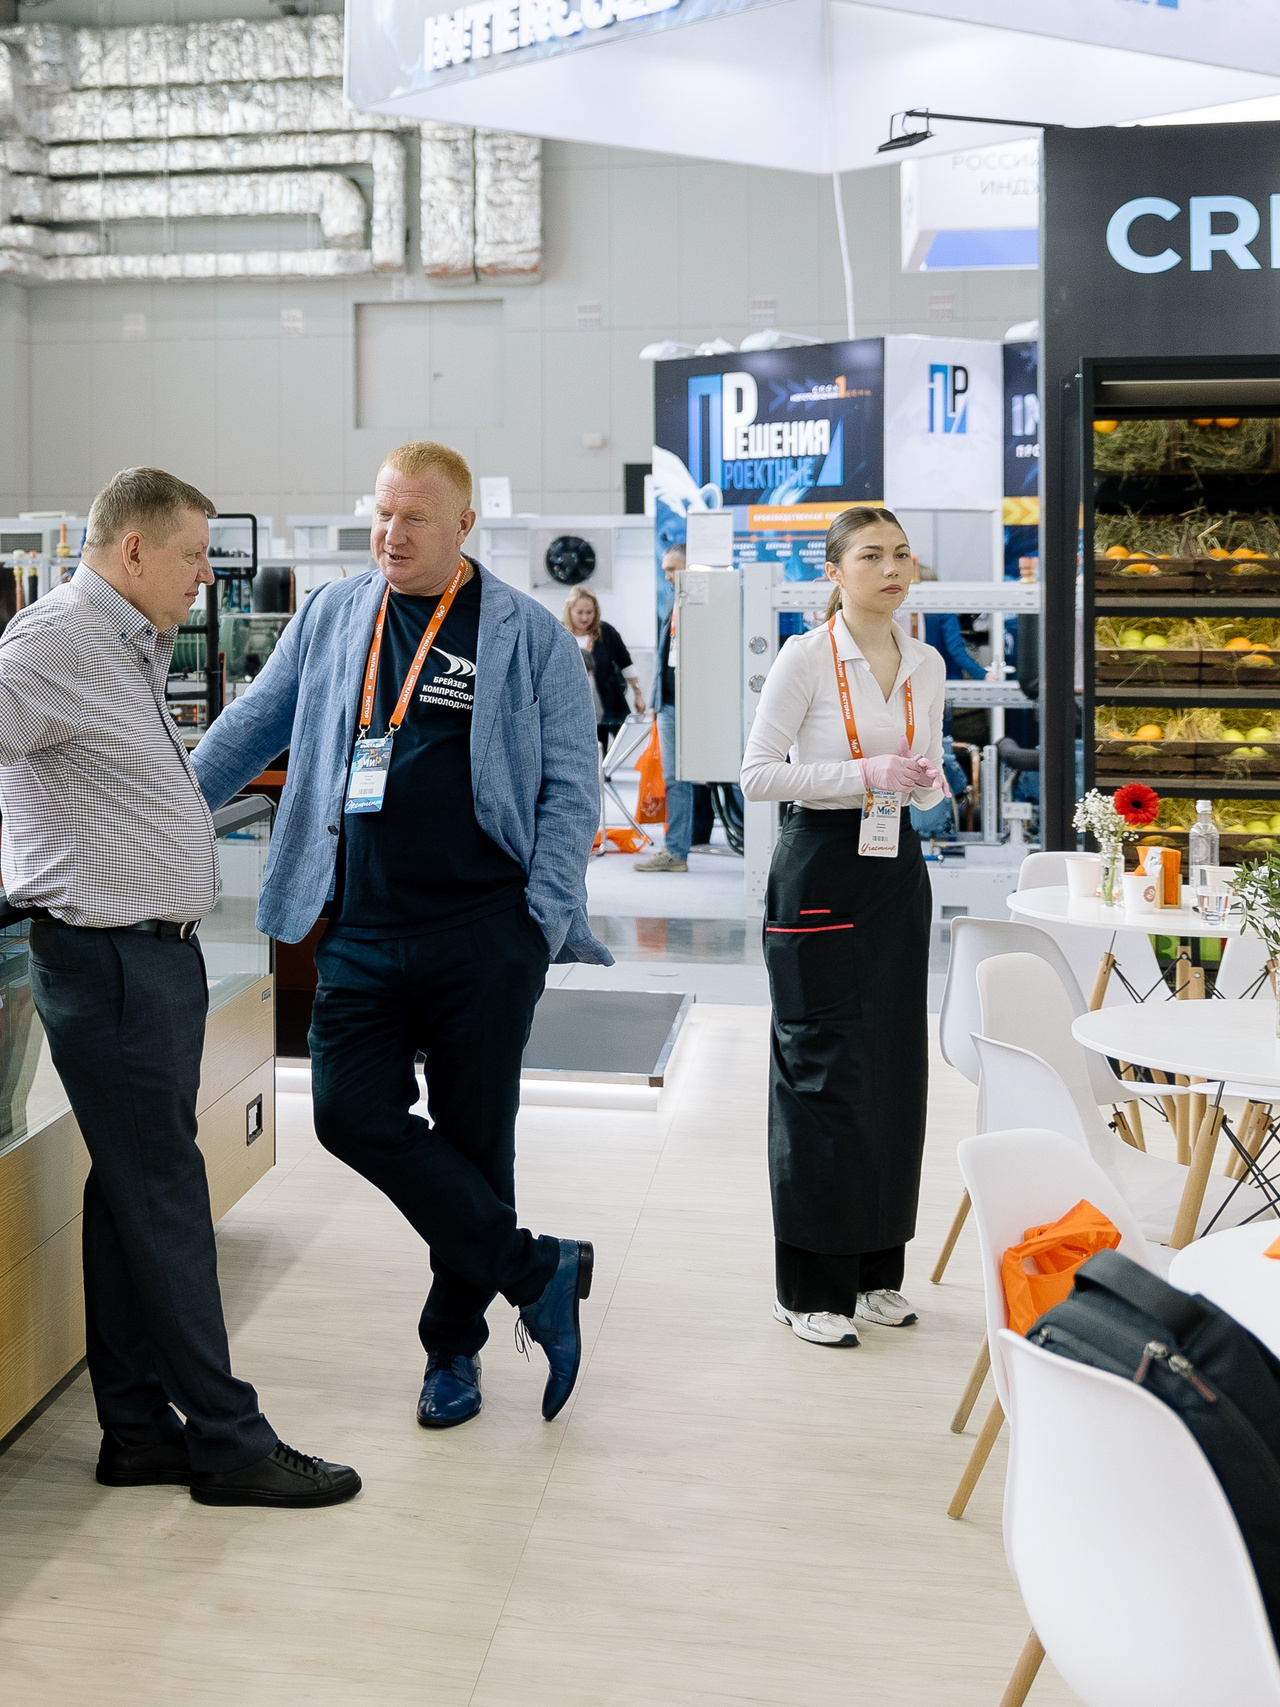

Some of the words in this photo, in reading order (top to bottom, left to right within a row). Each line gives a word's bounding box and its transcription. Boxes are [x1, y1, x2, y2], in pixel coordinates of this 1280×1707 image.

[402, 674, 416, 703] МАГАЗИН
[418, 631, 434, 661] РЕСТОРАН
[422, 684, 474, 702] КОМПРЕССОР
[433, 676, 468, 689] БРЕЙЗЕР
[841, 691, 851, 720] РЕСТОРАН
